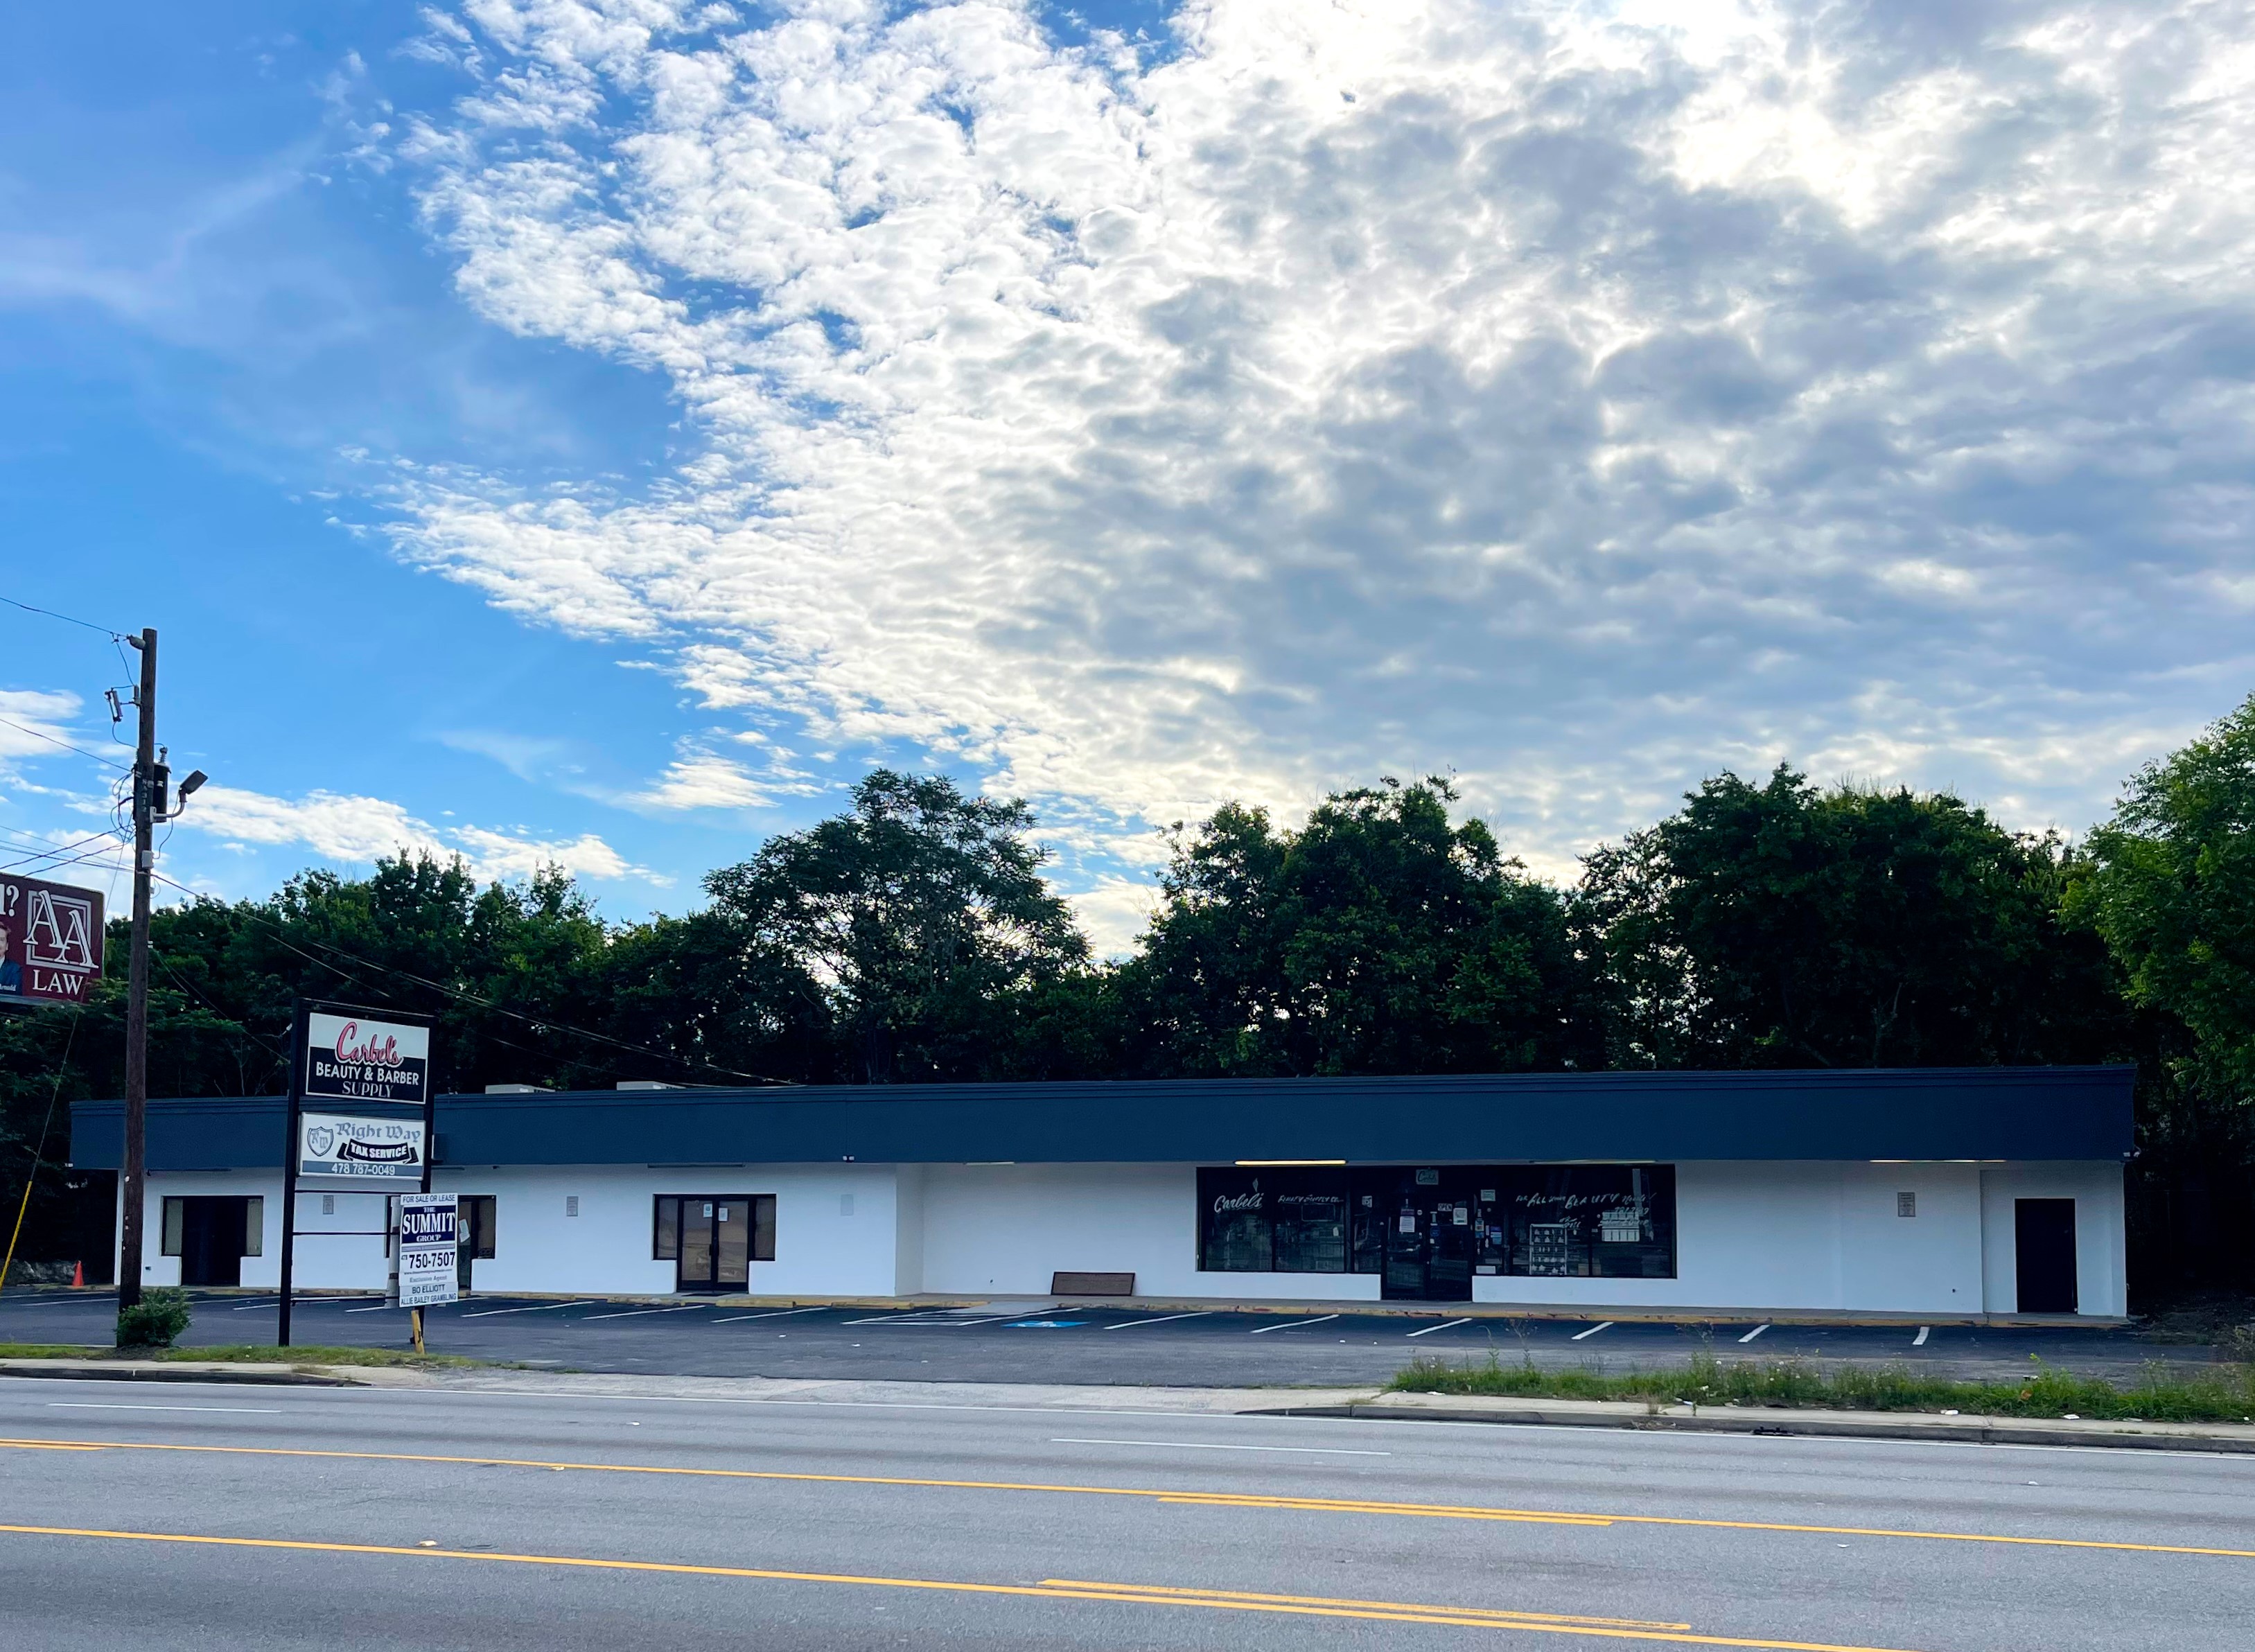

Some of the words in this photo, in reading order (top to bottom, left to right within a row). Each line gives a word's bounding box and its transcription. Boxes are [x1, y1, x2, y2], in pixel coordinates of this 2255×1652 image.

[33, 969, 83, 995] LAW
[337, 1021, 402, 1064] Carbel's
[316, 1062, 361, 1080] BEAUTY
[364, 1067, 373, 1081] &
[377, 1068, 419, 1085] BARBER
[342, 1081, 394, 1098] SUPPLY
[335, 1122, 382, 1140] Right
[385, 1125, 421, 1143] Way
[351, 1142, 368, 1157] TAX
[369, 1145, 407, 1159] SERVICE
[332, 1163, 350, 1174] 478
[353, 1163, 396, 1176] 787-0049
[402, 1213, 455, 1235] SUMMIT
[416, 1234, 441, 1242] GROUP
[422, 1284, 446, 1294] ELLIOTT
